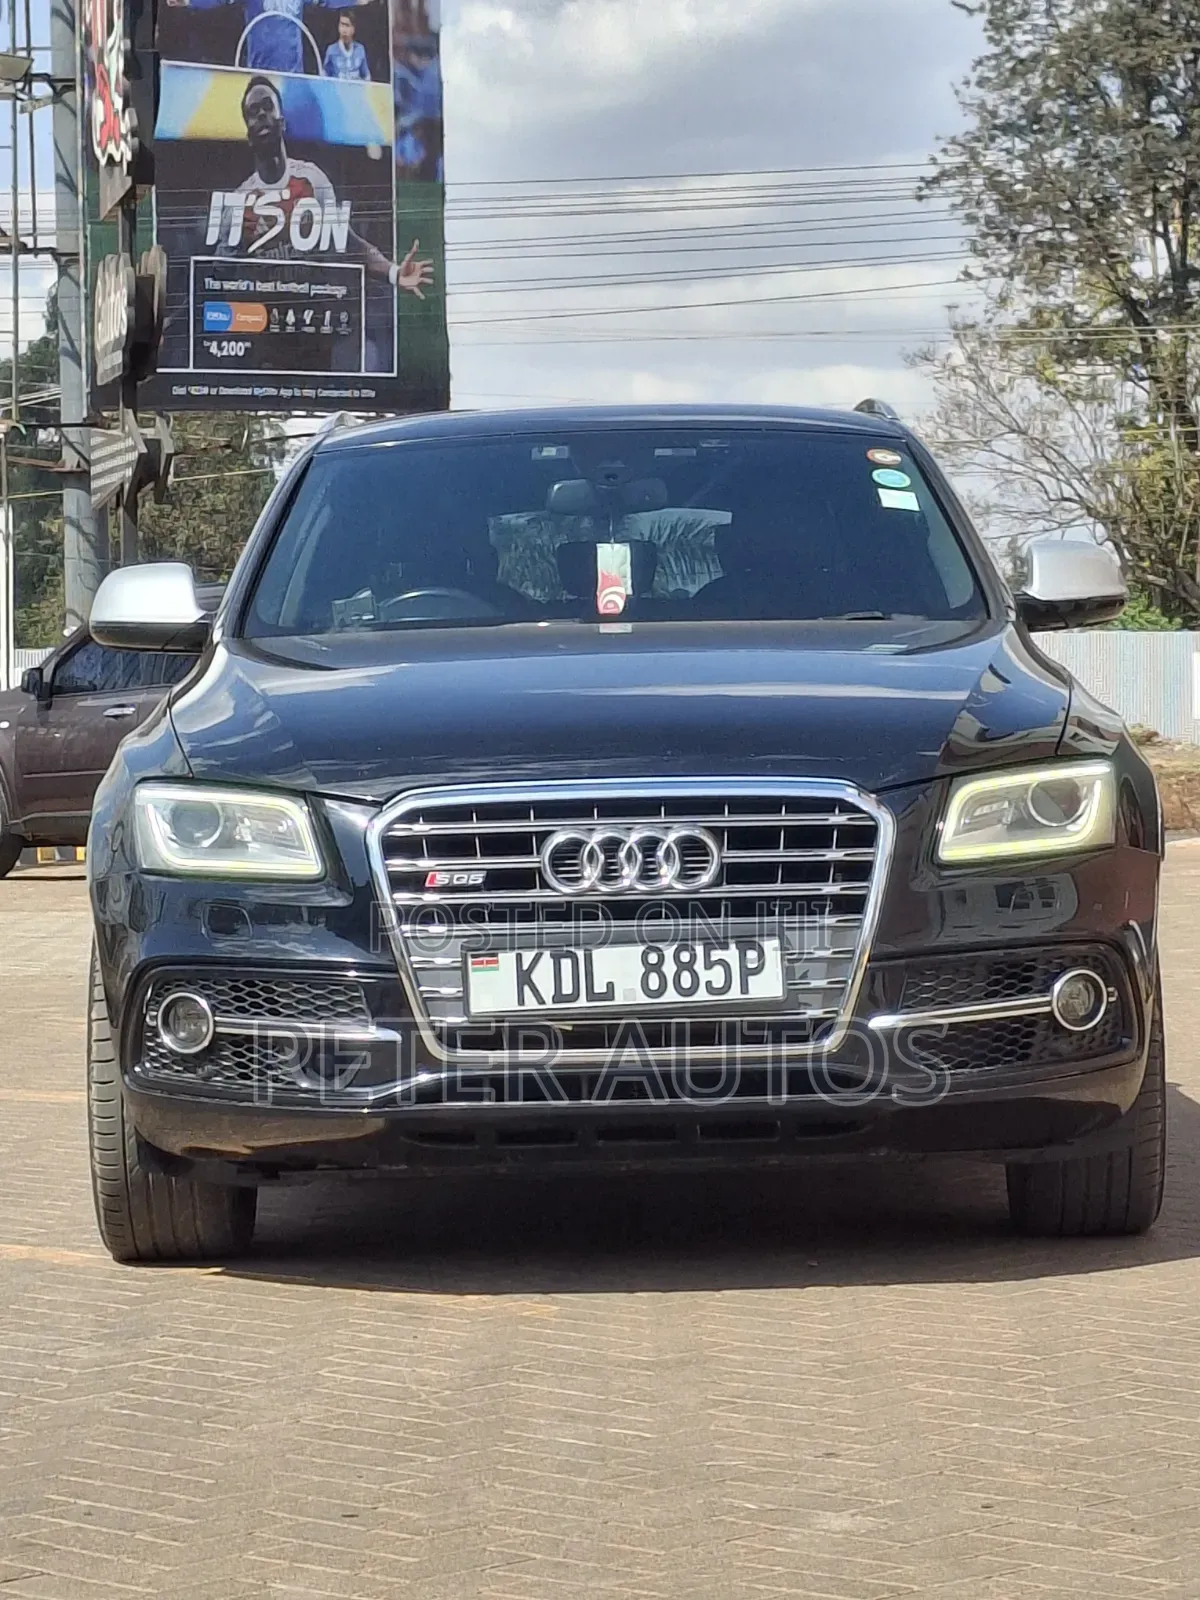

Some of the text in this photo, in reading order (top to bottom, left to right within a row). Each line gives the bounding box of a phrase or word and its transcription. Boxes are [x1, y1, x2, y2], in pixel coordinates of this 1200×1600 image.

[205, 189, 351, 254] IT'S ON
[434, 872, 485, 886] SQ5
[515, 940, 765, 1006] KDL 885P
